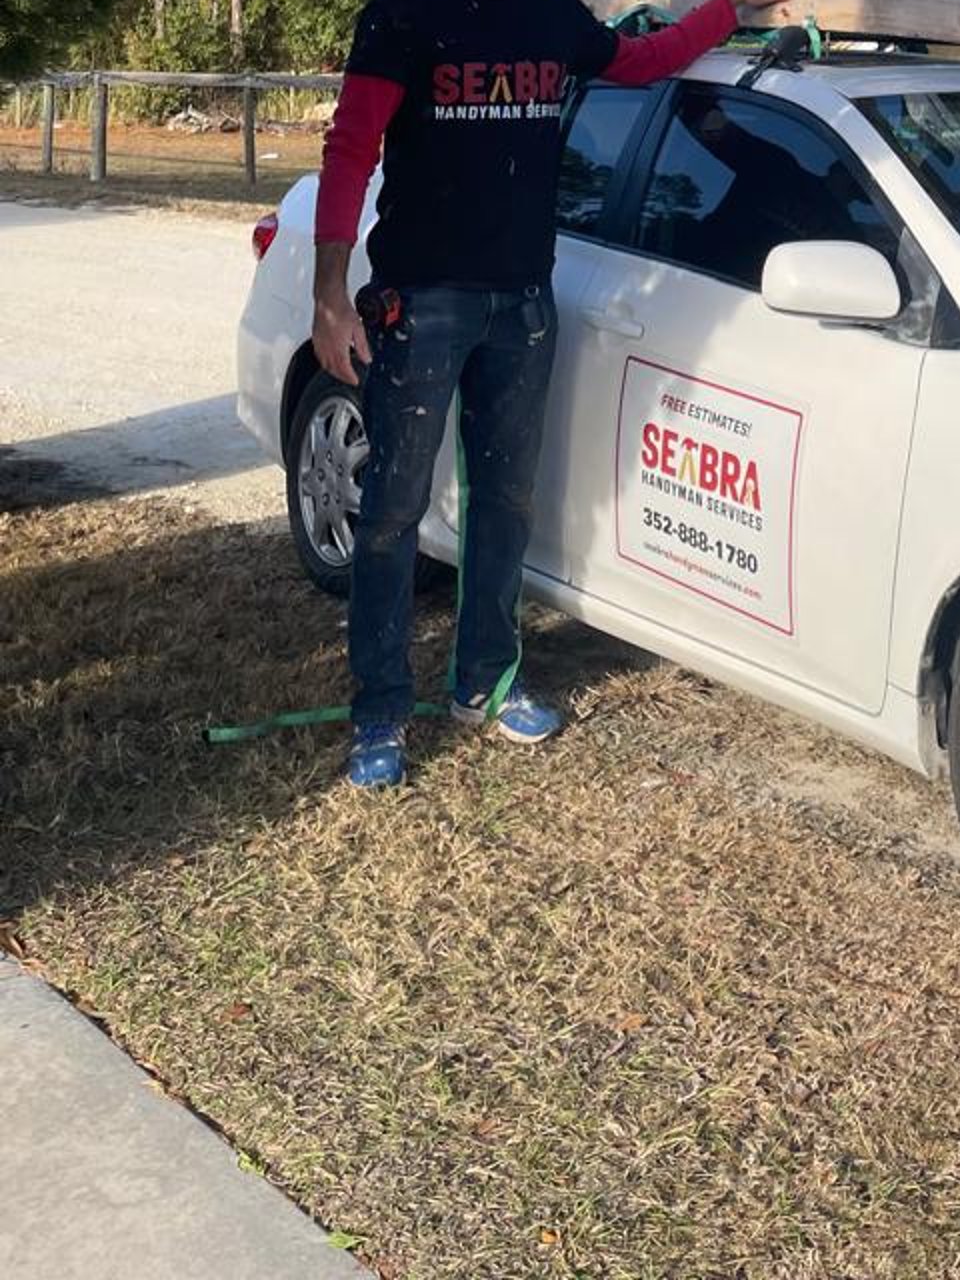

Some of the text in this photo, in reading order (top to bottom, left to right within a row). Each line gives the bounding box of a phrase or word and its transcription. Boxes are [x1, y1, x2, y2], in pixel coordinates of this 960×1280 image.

[434, 104, 521, 120] HANDYMAN
[660, 393, 752, 439] FREE ESTIMATES!
[641, 422, 761, 511] SEABRA
[641, 469, 763, 532] HANDYMAN SERVICES
[643, 507, 758, 574] 352-888-1780
